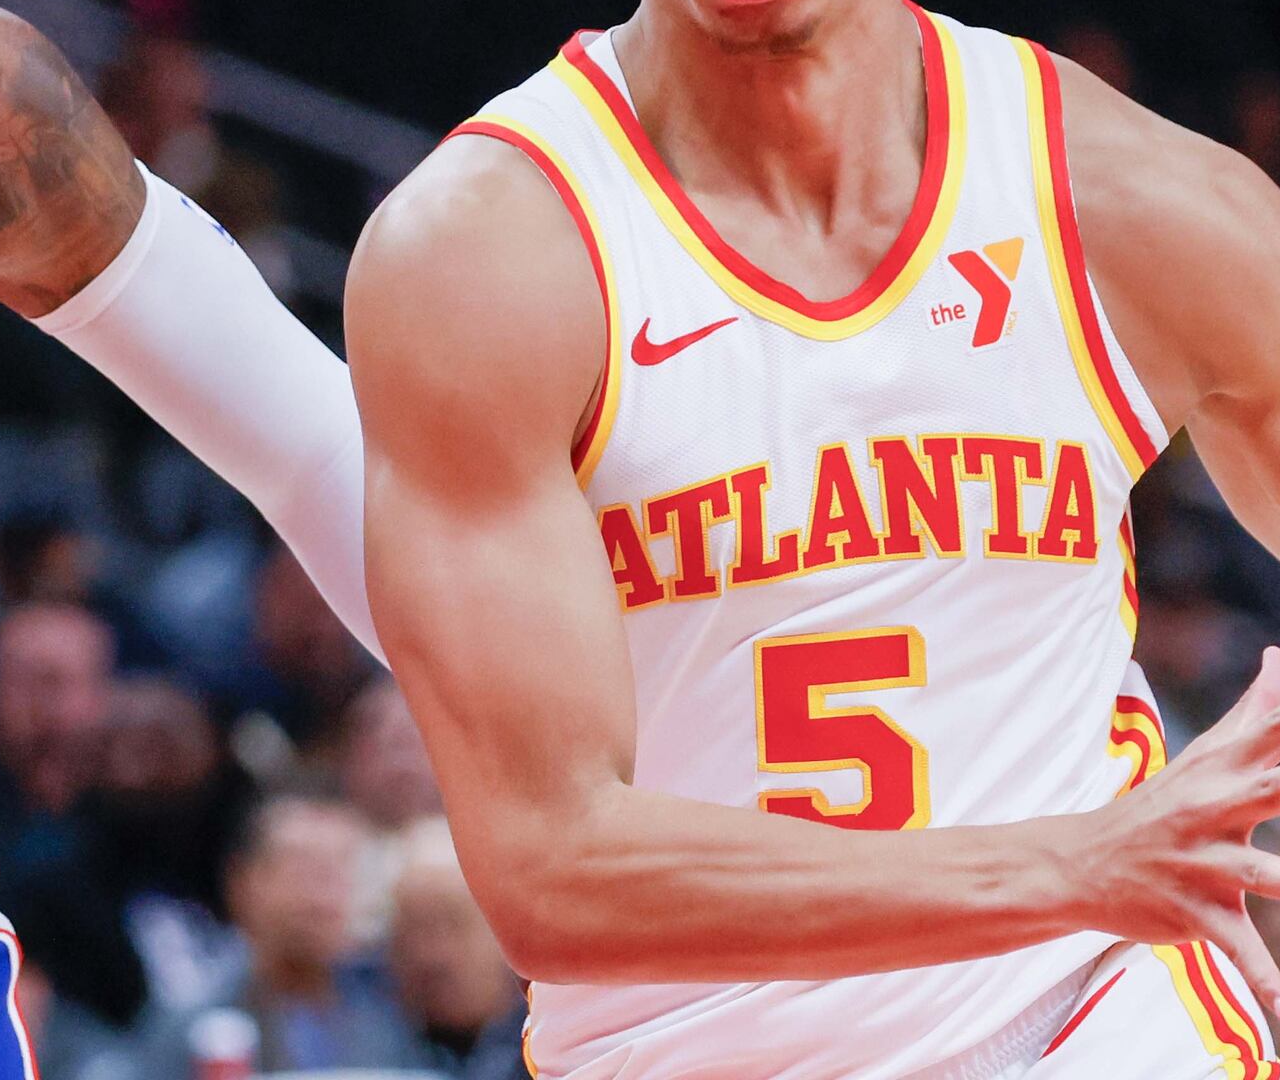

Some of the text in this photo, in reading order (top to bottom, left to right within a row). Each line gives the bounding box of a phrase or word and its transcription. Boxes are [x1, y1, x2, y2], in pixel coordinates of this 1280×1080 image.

[930, 303, 967, 326] the
[597, 431, 1099, 613] ATLANTA
[752, 625, 932, 832] 5
